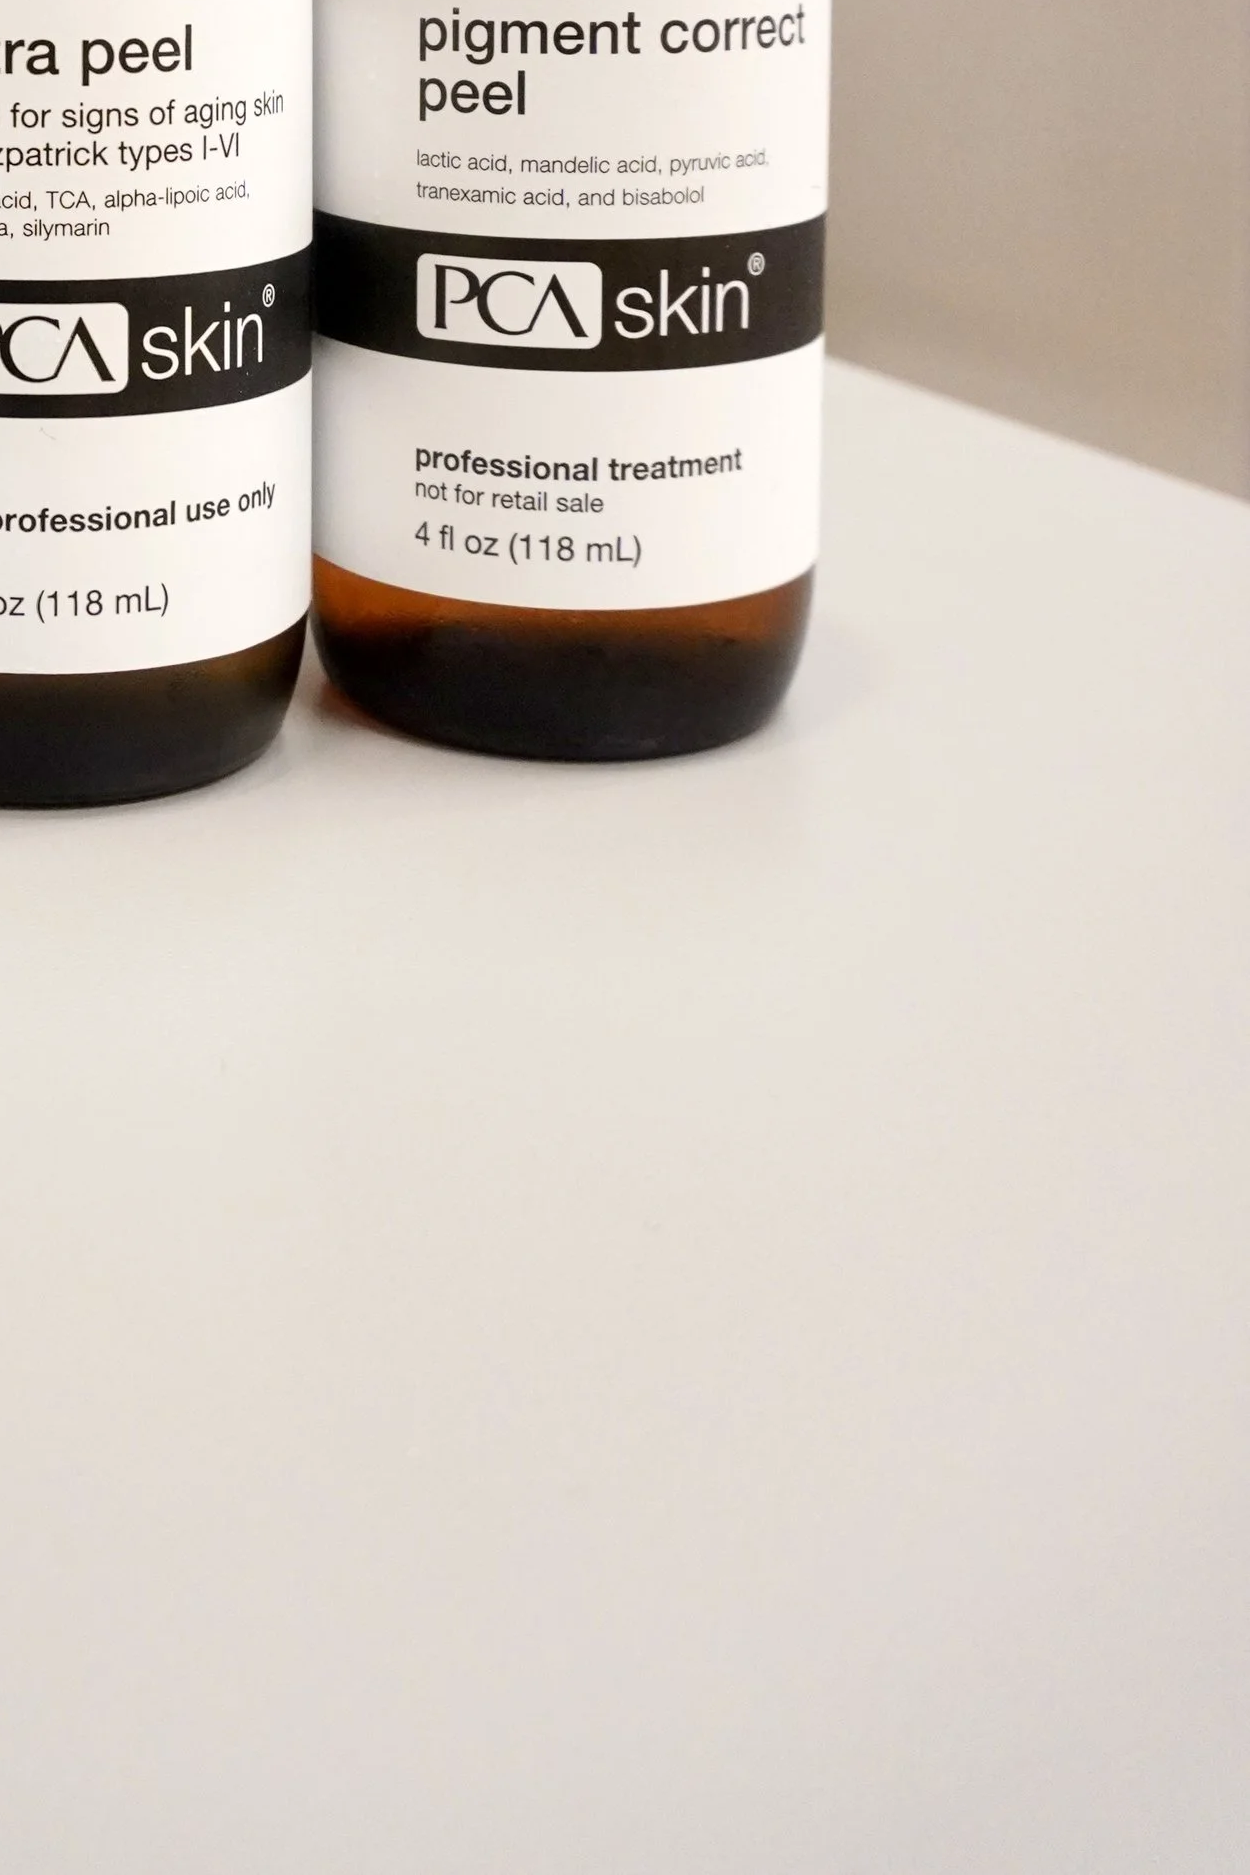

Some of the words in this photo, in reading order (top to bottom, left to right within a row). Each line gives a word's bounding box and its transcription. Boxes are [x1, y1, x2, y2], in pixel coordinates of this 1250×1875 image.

[81, 23, 192, 87] peel
[419, 7, 641, 66] pigment
[660, 6, 805, 55] correct
[10, 102, 52, 129] for
[61, 101, 139, 135] signs
[149, 98, 176, 126] of
[184, 96, 247, 130] aging
[253, 91, 284, 117] skin
[419, 69, 526, 122] peel
[117, 141, 193, 171] types
[203, 132, 239, 161] I-VI
[416, 148, 462, 170] lactic
[467, 154, 513, 175] acid,
[520, 156, 610, 174] mandelic
[616, 155, 662, 174] acid,
[669, 155, 731, 177] pyruvic
[45, 190, 96, 211] TCA,
[104, 187, 210, 212] alpha-lipoic
[215, 180, 250, 201] acid,
[416, 181, 517, 205] tranexamic
[522, 188, 570, 208] acid,
[577, 188, 615, 207] and
[622, 186, 704, 206] bisabolol
[22, 218, 110, 242] silymarin
[433, 263, 589, 338] PCA
[415, 447, 598, 482] professional
[607, 448, 742, 482] treatment
[186, 498, 231, 523] use
[238, 480, 276, 513] only
[415, 482, 448, 502] not
[453, 483, 485, 506] for
[492, 490, 548, 512] retail
[556, 492, 604, 514] sale
[414, 521, 431, 547] 4
[439, 524, 454, 551] fl
[464, 534, 499, 557] oz
[509, 532, 575, 566] (118
[586, 535, 642, 568] mL)
[36, 589, 103, 624] (118
[115, 582, 169, 617] mL)
